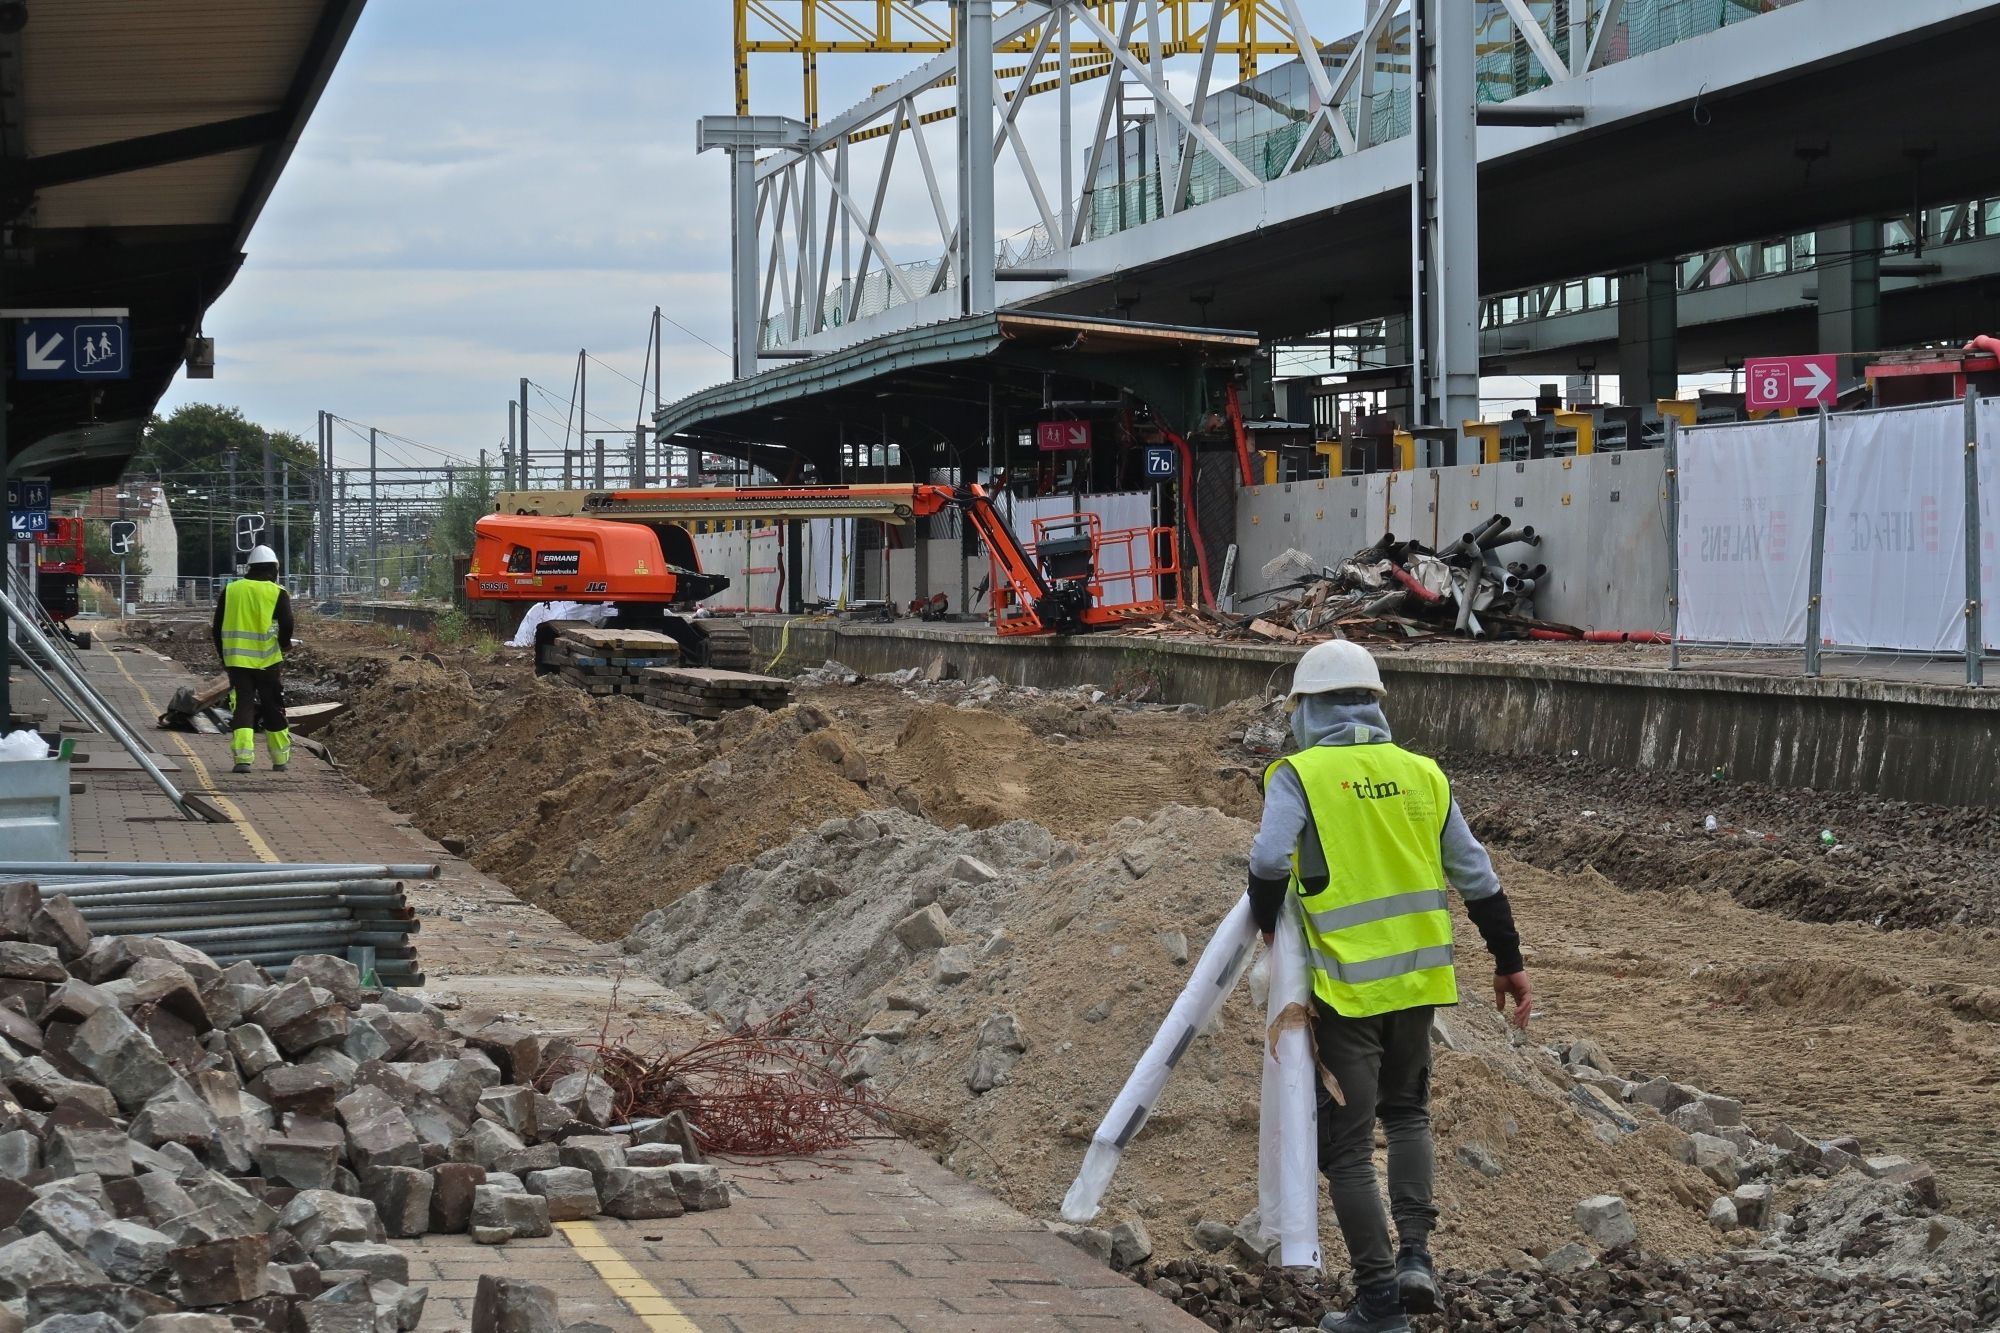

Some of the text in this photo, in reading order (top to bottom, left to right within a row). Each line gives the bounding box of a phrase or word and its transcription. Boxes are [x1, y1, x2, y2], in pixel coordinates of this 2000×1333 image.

[1763, 377, 1778, 399] 8
[1150, 456, 1170, 471] 7b
[480, 582, 508, 592] 660SJC
[585, 581, 607, 592] JLG
